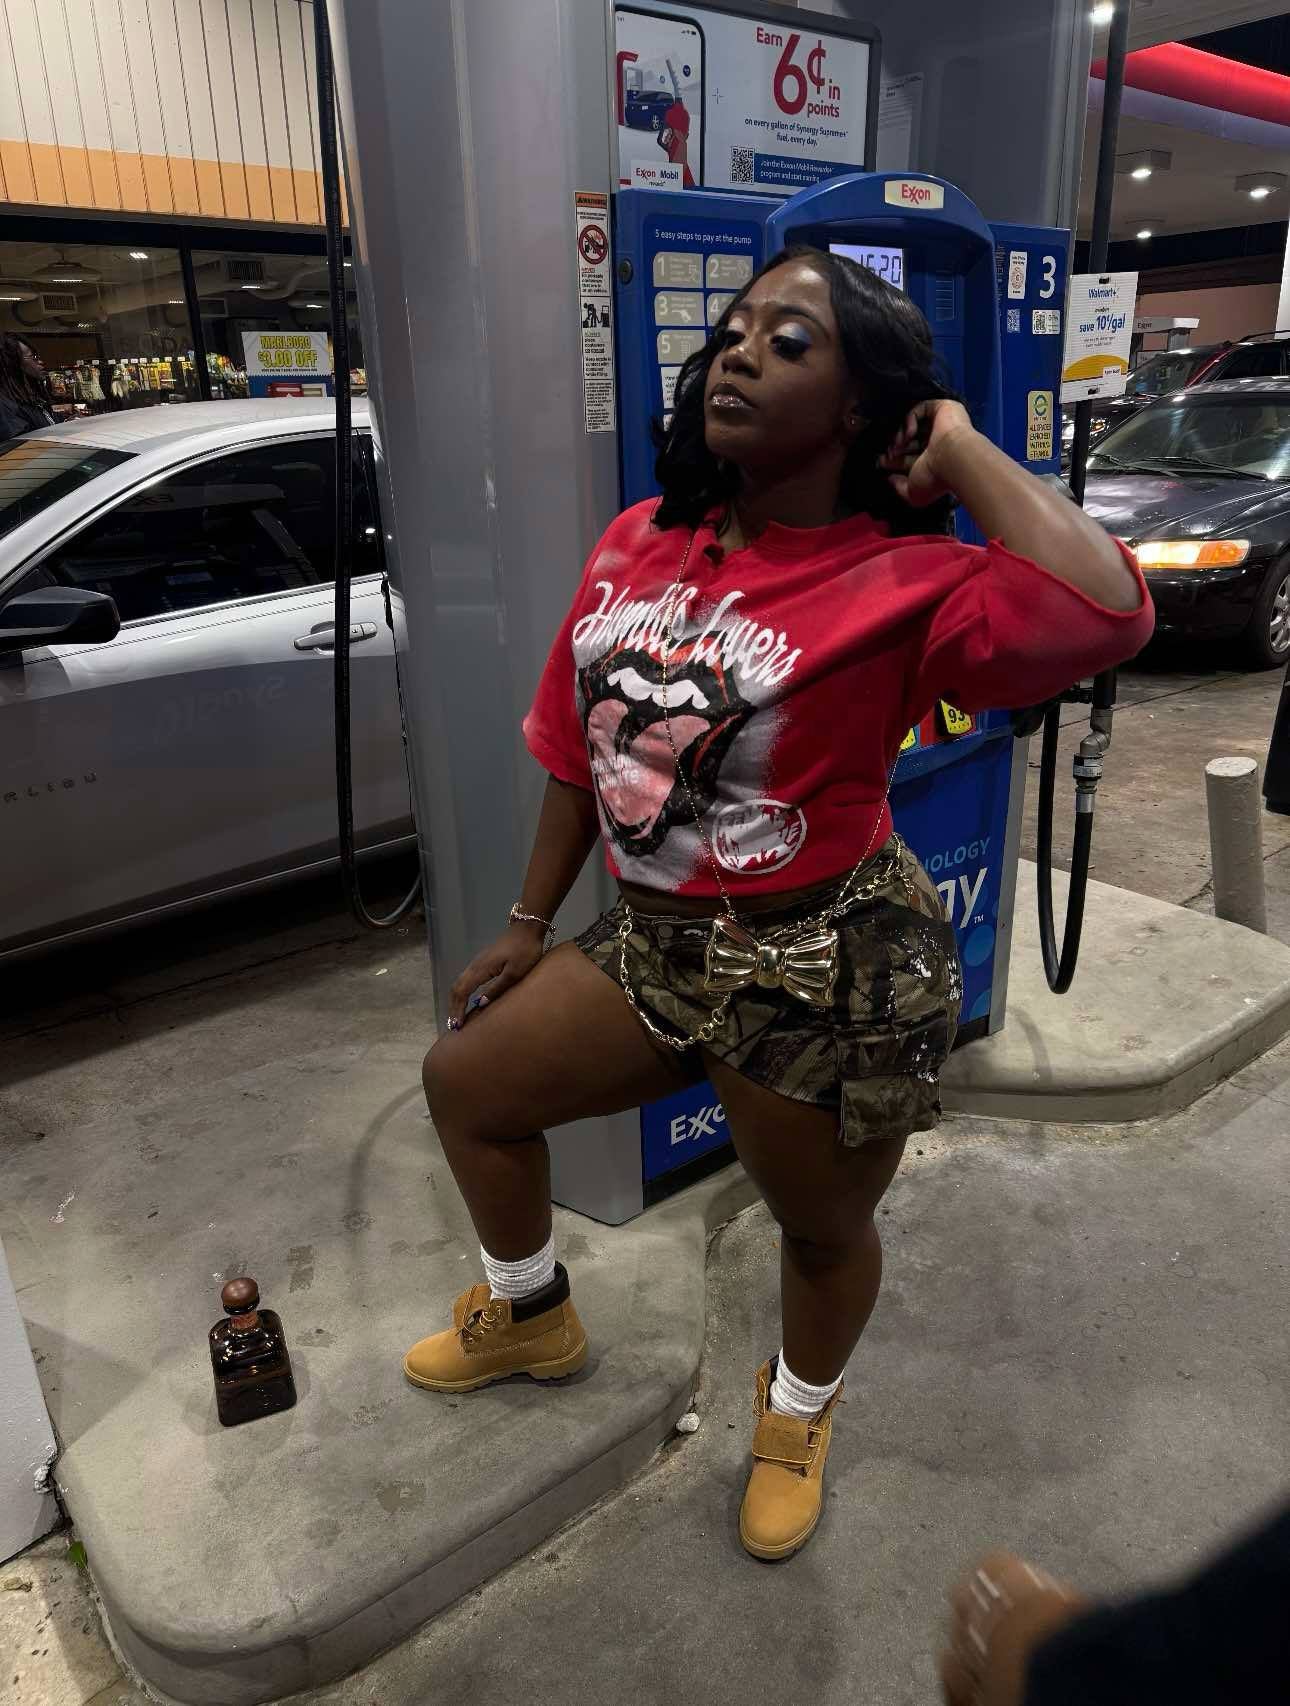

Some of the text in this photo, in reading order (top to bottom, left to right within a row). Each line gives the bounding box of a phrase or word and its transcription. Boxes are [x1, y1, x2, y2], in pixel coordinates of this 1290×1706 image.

[756, 27, 782, 46] Earn
[828, 79, 840, 101] in
[807, 103, 840, 118] points
[753, 118, 769, 129] every
[770, 121, 789, 131] gallon
[789, 122, 796, 130] of
[796, 123, 819, 136] Synergy
[776, 132, 789, 143] fuel,
[790, 135, 806, 146] every
[635, 167, 679, 180] Exxon Mobil
[901, 184, 931, 204] Exxon
[656, 228, 660, 238] 5
[660, 231, 676, 240] easy
[676, 232, 694, 242] steps
[694, 233, 702, 241] to
[702, 234, 715, 243] pay
[722, 234, 733, 243] the
[734, 236, 752, 245] pump
[657, 256, 665, 277] 1
[710, 258, 719, 278] 2
[1040, 255, 1057, 299] 3
[660, 295, 668, 316] 3
[710, 297, 720, 318] 4
[1080, 323, 1095, 333] save
[260, 335, 311, 349] MARLBORO
[661, 334, 671, 354] 5
[294, 350, 318, 368] OFF
[686, 590, 803, 687] Lovers
